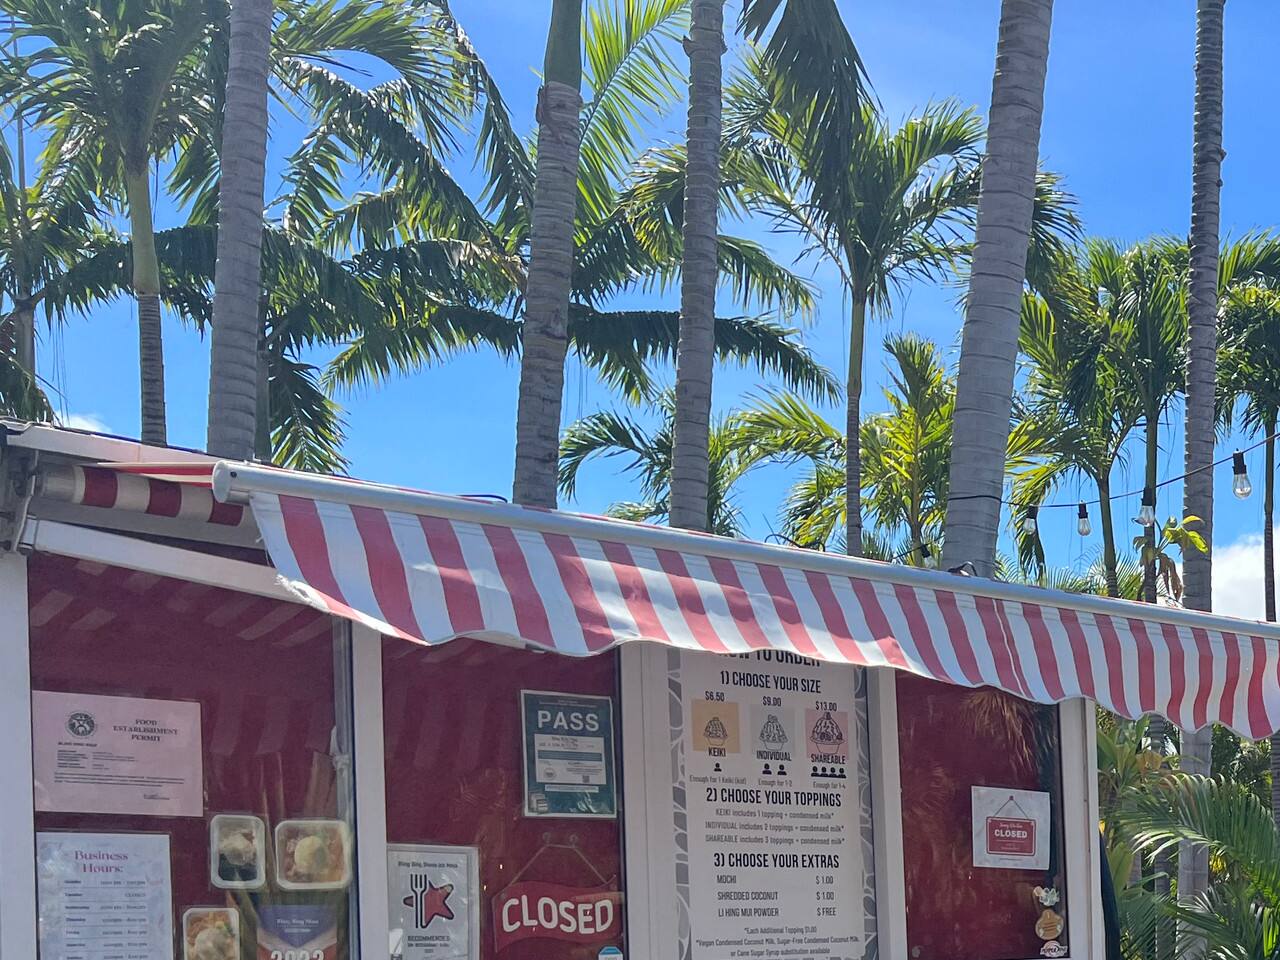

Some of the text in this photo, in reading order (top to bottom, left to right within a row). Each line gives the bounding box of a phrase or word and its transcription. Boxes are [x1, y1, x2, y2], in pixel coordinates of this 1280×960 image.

[720, 671, 821, 693] 1) CHOOSE YOUR SIZE
[705, 691, 725, 702] $6.50
[763, 696, 781, 707] $9.00
[816, 701, 837, 711] $13.00
[537, 710, 599, 732] PASS
[708, 747, 726, 757] KEIKI
[756, 751, 792, 762] INDIVIDUAL
[810, 754, 845, 765] SHAREABLE
[706, 788, 841, 807] 2) CHOOSE YOUR TOPPINGS
[994, 829, 1027, 839] CLOSED
[75, 850, 129, 860] Business
[714, 853, 839, 868] 3) CHOOSE YOUR EXTRAS
[717, 875, 737, 884] MOCHI
[717, 891, 750, 900] SHREDDED
[751, 892, 778, 900] COCONUT
[502, 895, 614, 934] CLOSED
[725, 908, 740, 917] HING
[753, 908, 779, 917] POWDER
[822, 907, 836, 916] FREE
